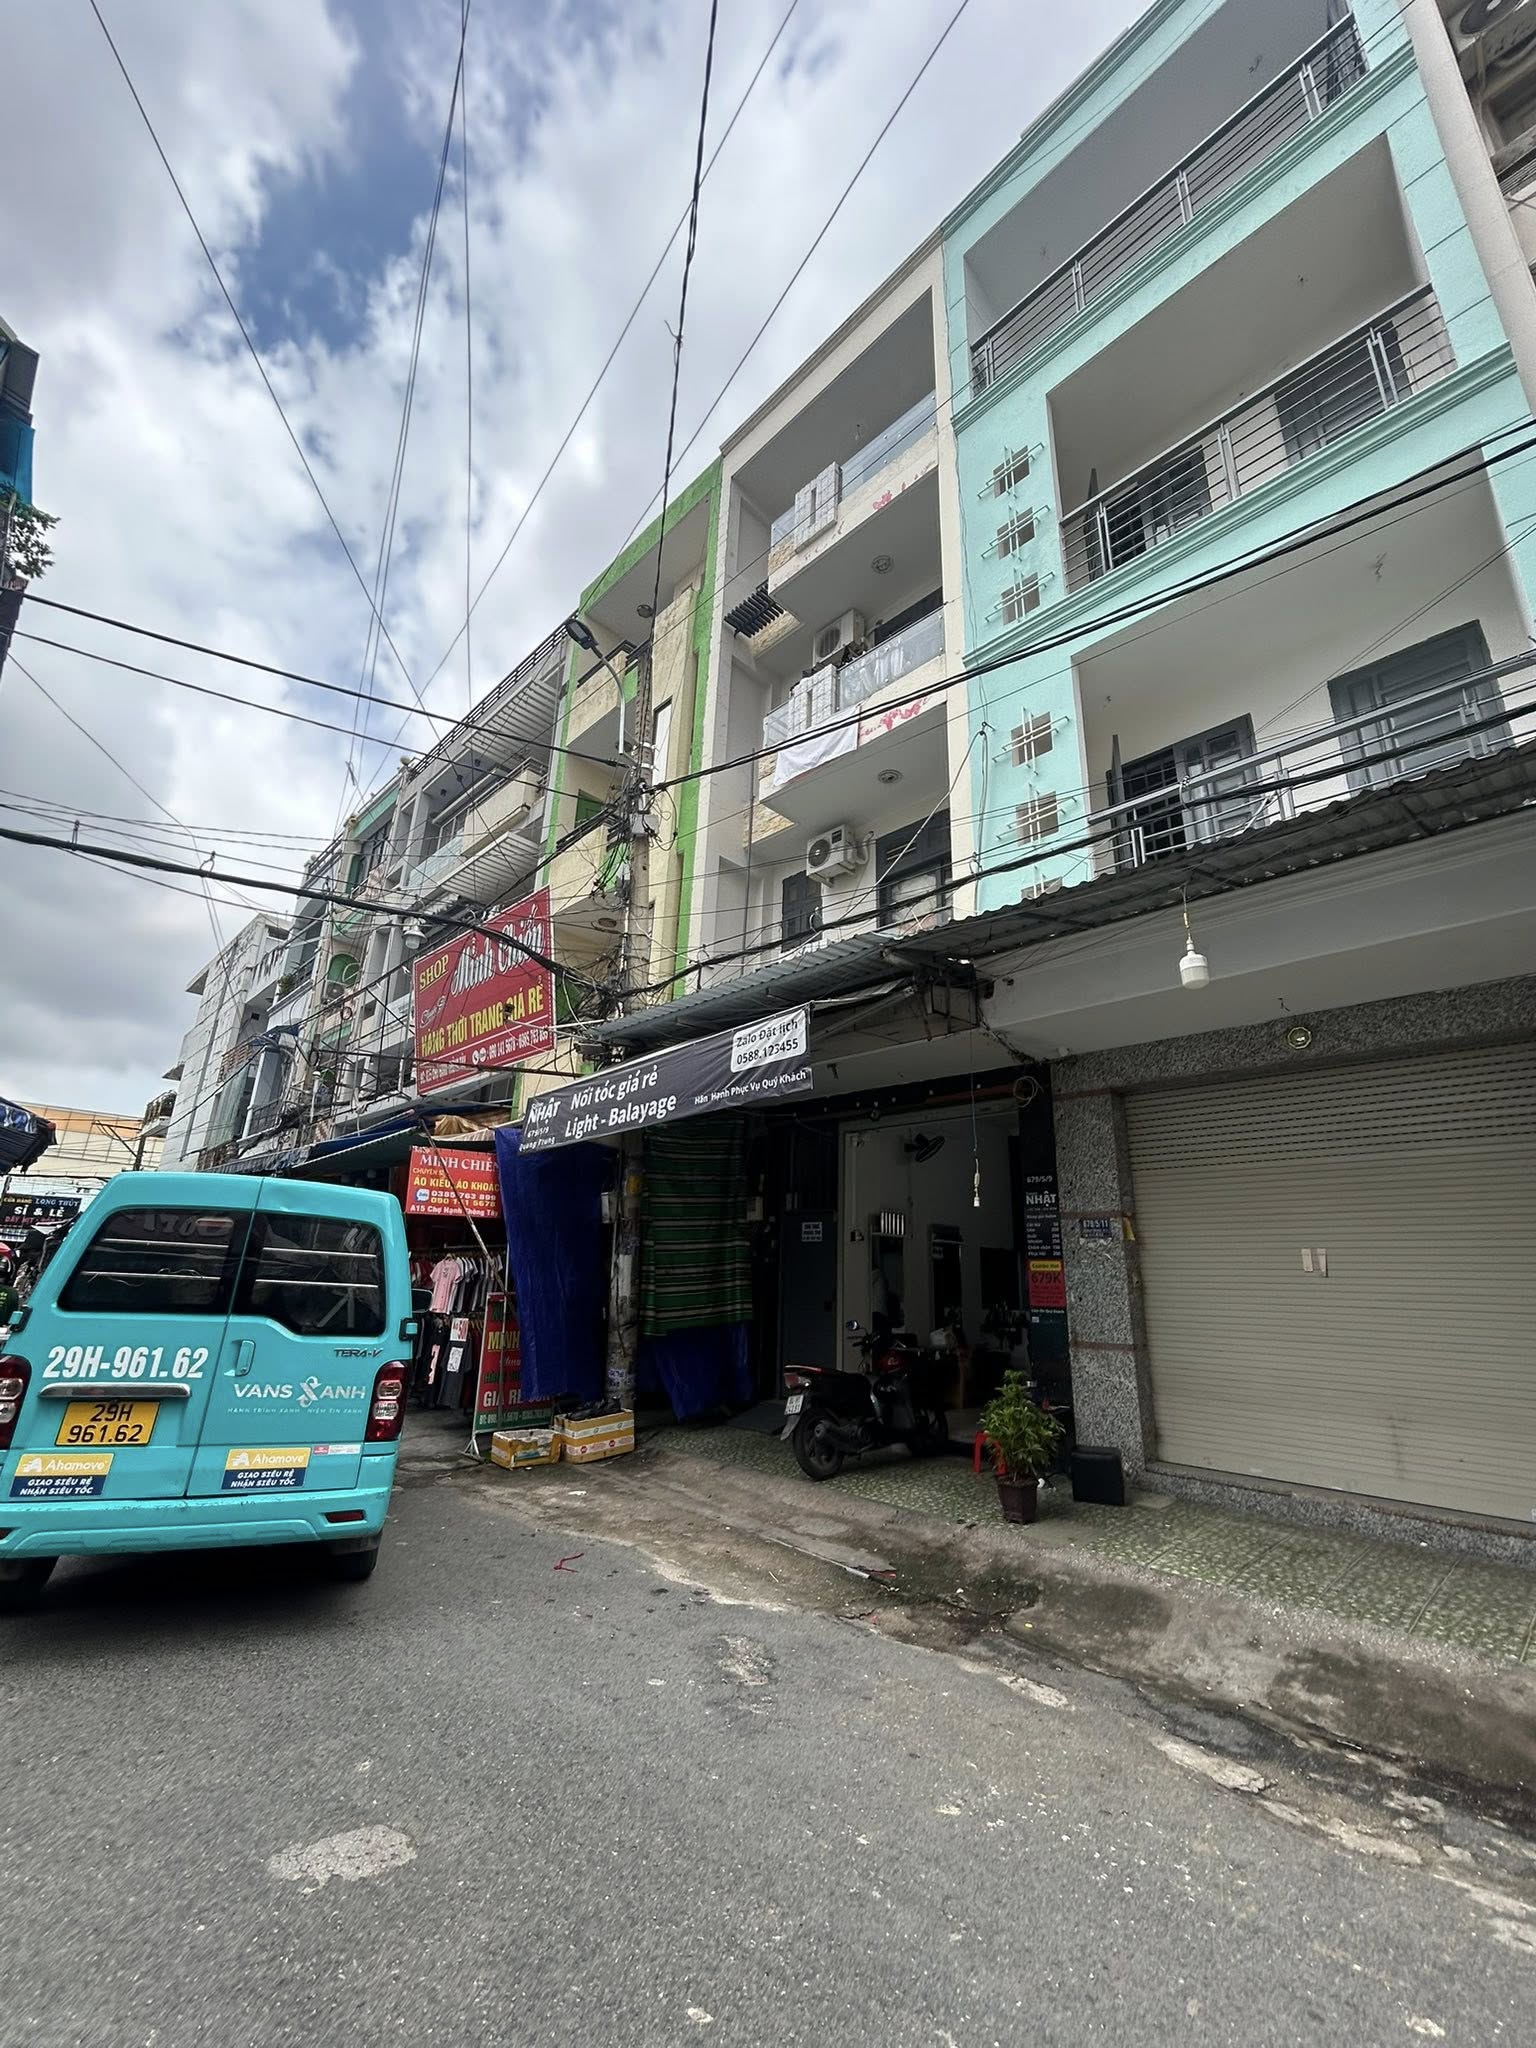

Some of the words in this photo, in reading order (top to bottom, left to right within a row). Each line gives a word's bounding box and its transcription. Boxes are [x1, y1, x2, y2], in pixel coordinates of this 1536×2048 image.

[419, 953, 449, 990] SHOP
[421, 1025, 445, 1057] HÀNG
[447, 1015, 468, 1047] THỜI
[470, 1001, 504, 1039] TRANG
[736, 1033, 757, 1048] Zalo
[759, 1027, 777, 1041] Đặt
[779, 1019, 798, 1036] lịch
[736, 1038, 799, 1065] 0588.123455
[570, 1086, 594, 1111] Nối
[594, 1079, 616, 1103] tóc
[619, 1070, 641, 1102] giá
[641, 1064, 658, 1089] rẻ
[731, 1084, 749, 1097] Phục
[750, 1081, 760, 1092] Vụ
[762, 1076, 778, 1089] Quý
[779, 1071, 806, 1085] Khách
[528, 1097, 561, 1125] NHẬT
[565, 1113, 599, 1139] Light
[609, 1093, 677, 1128] Balayage
[420, 1155, 458, 1169] MINH
[414, 1174, 426, 1186] ÁO
[35, 1198, 56, 1206] LONG
[1025, 1190, 1057, 1207] NHẬT
[33, 1207, 43, 1216] &
[410, 1205, 425, 1213] A15
[333, 1347, 383, 1359] TERA-V
[42, 1345, 209, 1379] 29H-961.62
[234, 1383, 293, 1399] VANS
[90, 1404, 133, 1422] 29H
[67, 1424, 144, 1443] 961.62
[45, 1459, 106, 1471] Ahamove
[252, 1454, 305, 1465] Ahamove
[54, 1477, 79, 1486] SIÊU
[237, 1471, 260, 1479] GIAO
[261, 1469, 282, 1479] SIÊU
[20, 1487, 47, 1497] NHẬN
[48, 1486, 73, 1495] SIÊU
[74, 1485, 94, 1495] TỐC
[231, 1480, 254, 1489] NHẬN
[255, 1478, 278, 1487] SIÊU
[279, 1477, 296, 1486] TỐC
